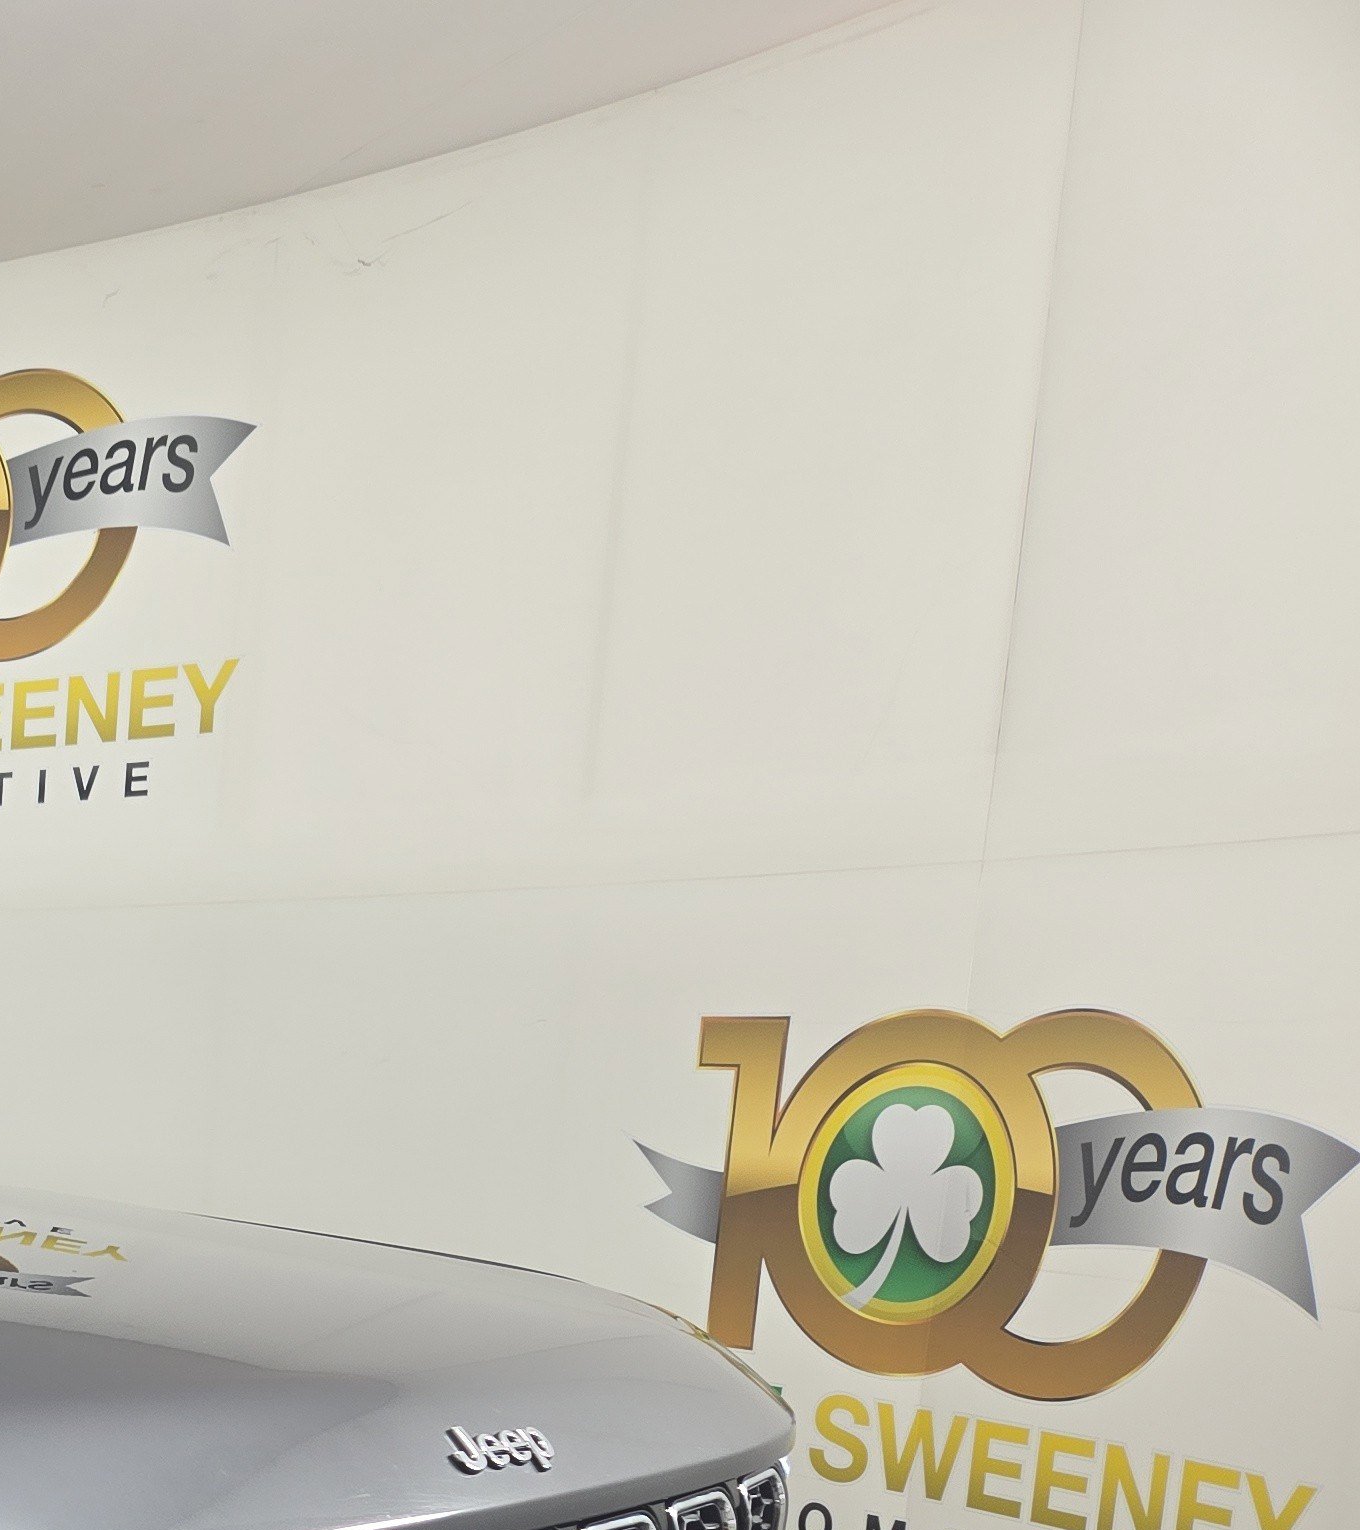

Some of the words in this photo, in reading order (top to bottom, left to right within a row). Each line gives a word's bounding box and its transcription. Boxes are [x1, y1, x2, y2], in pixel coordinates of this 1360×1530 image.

[23, 426, 200, 531] years
[1069, 1131, 1291, 1228] years
[445, 1425, 555, 1475] Jeep
